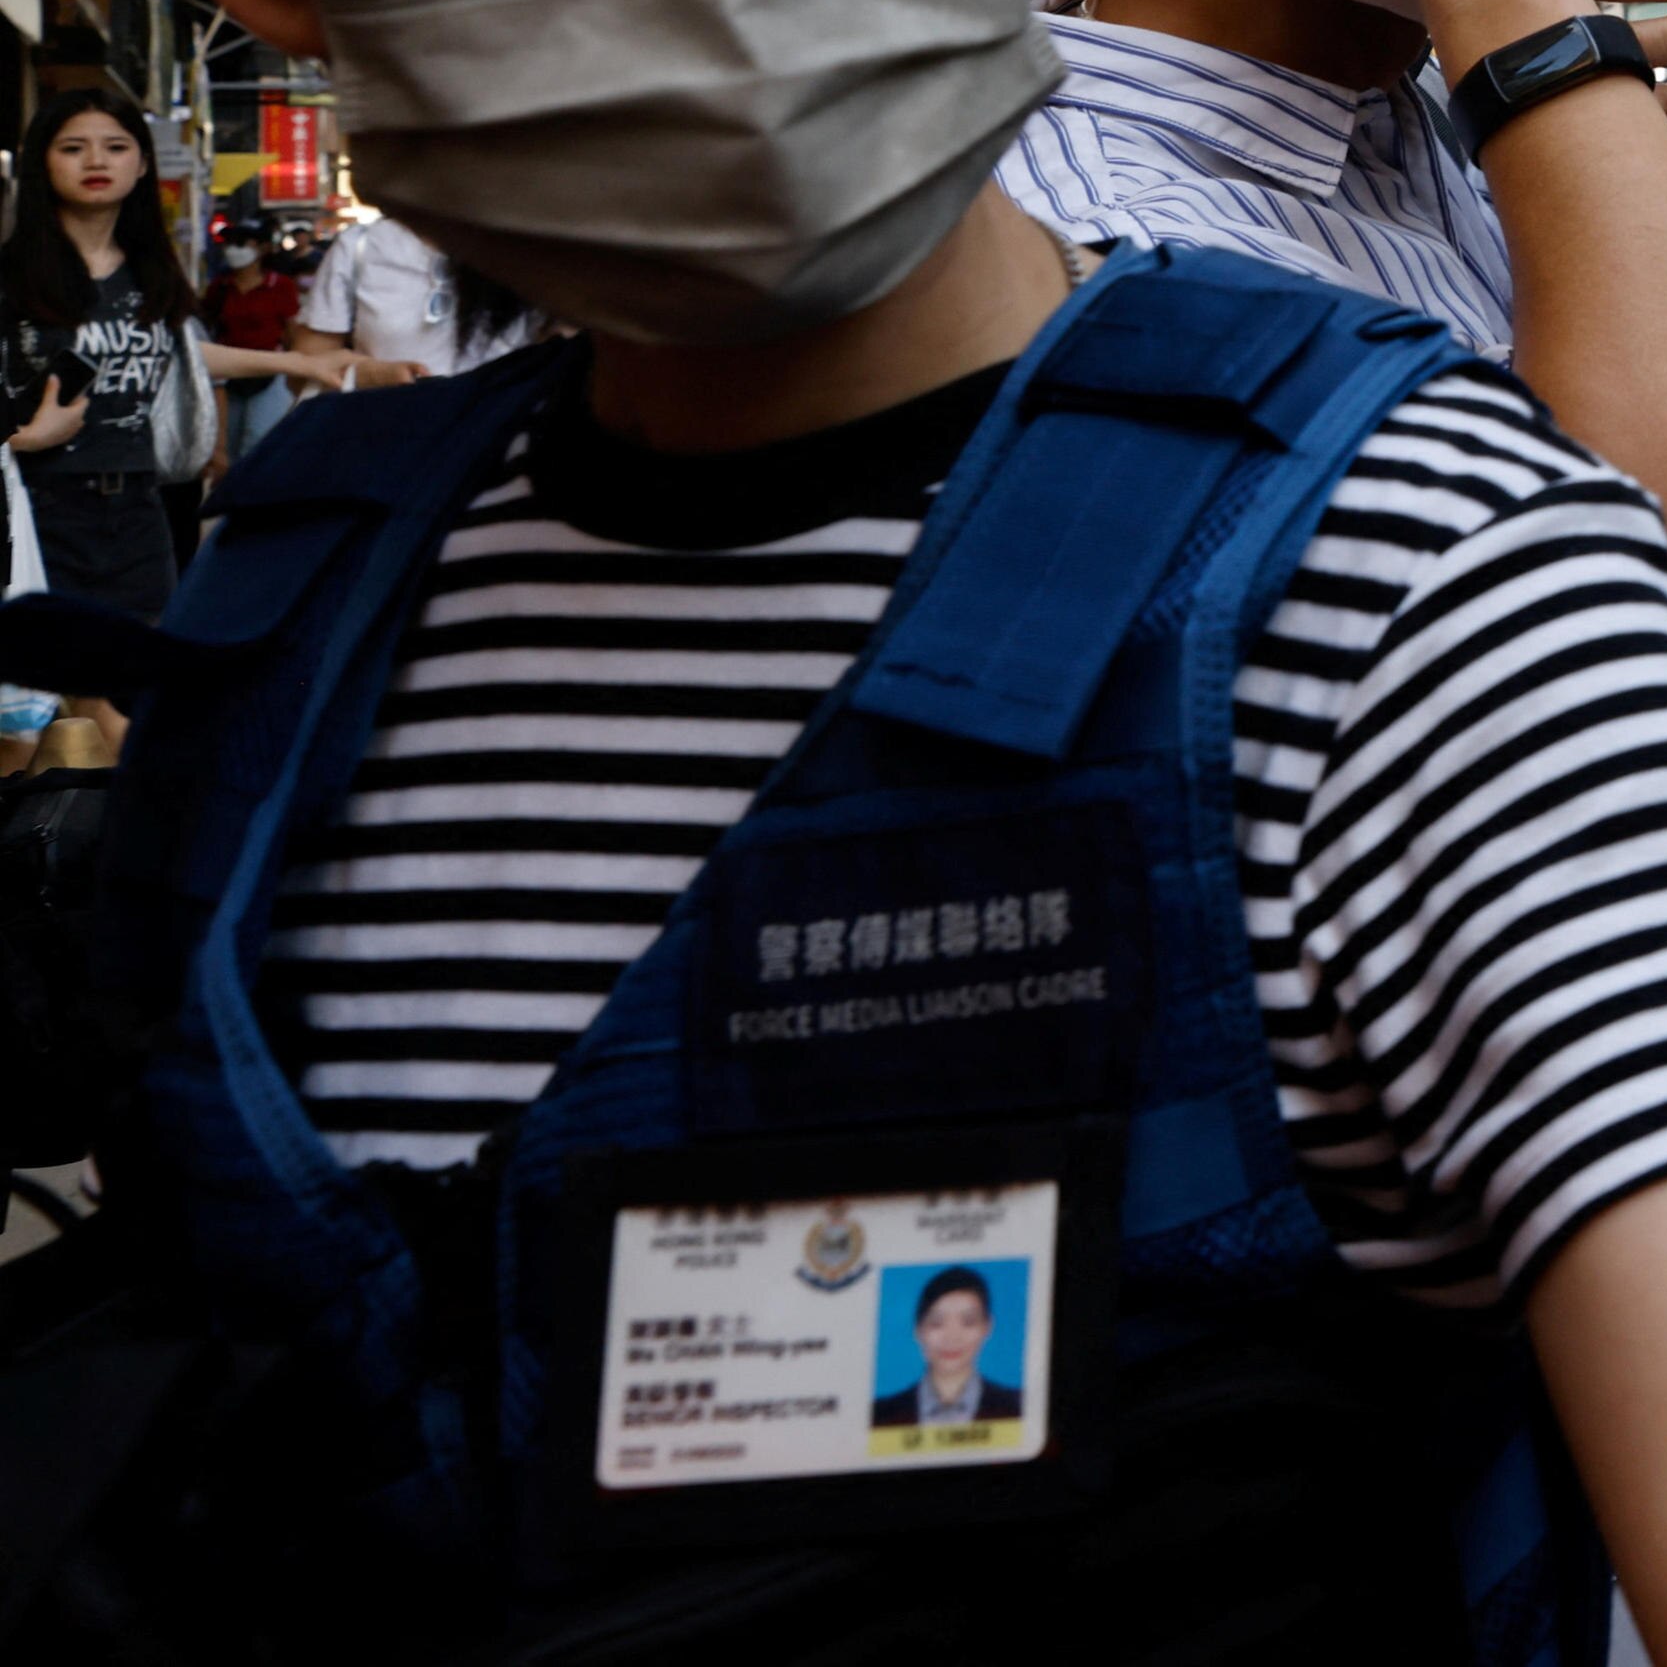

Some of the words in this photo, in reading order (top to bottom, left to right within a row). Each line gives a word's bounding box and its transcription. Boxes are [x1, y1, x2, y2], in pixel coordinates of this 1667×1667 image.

[727, 1004, 815, 1045] FORCE
[818, 995, 905, 1035] MEDIA
[905, 980, 1015, 1027] LIAISON
[1016, 964, 1108, 1010] CADRE
